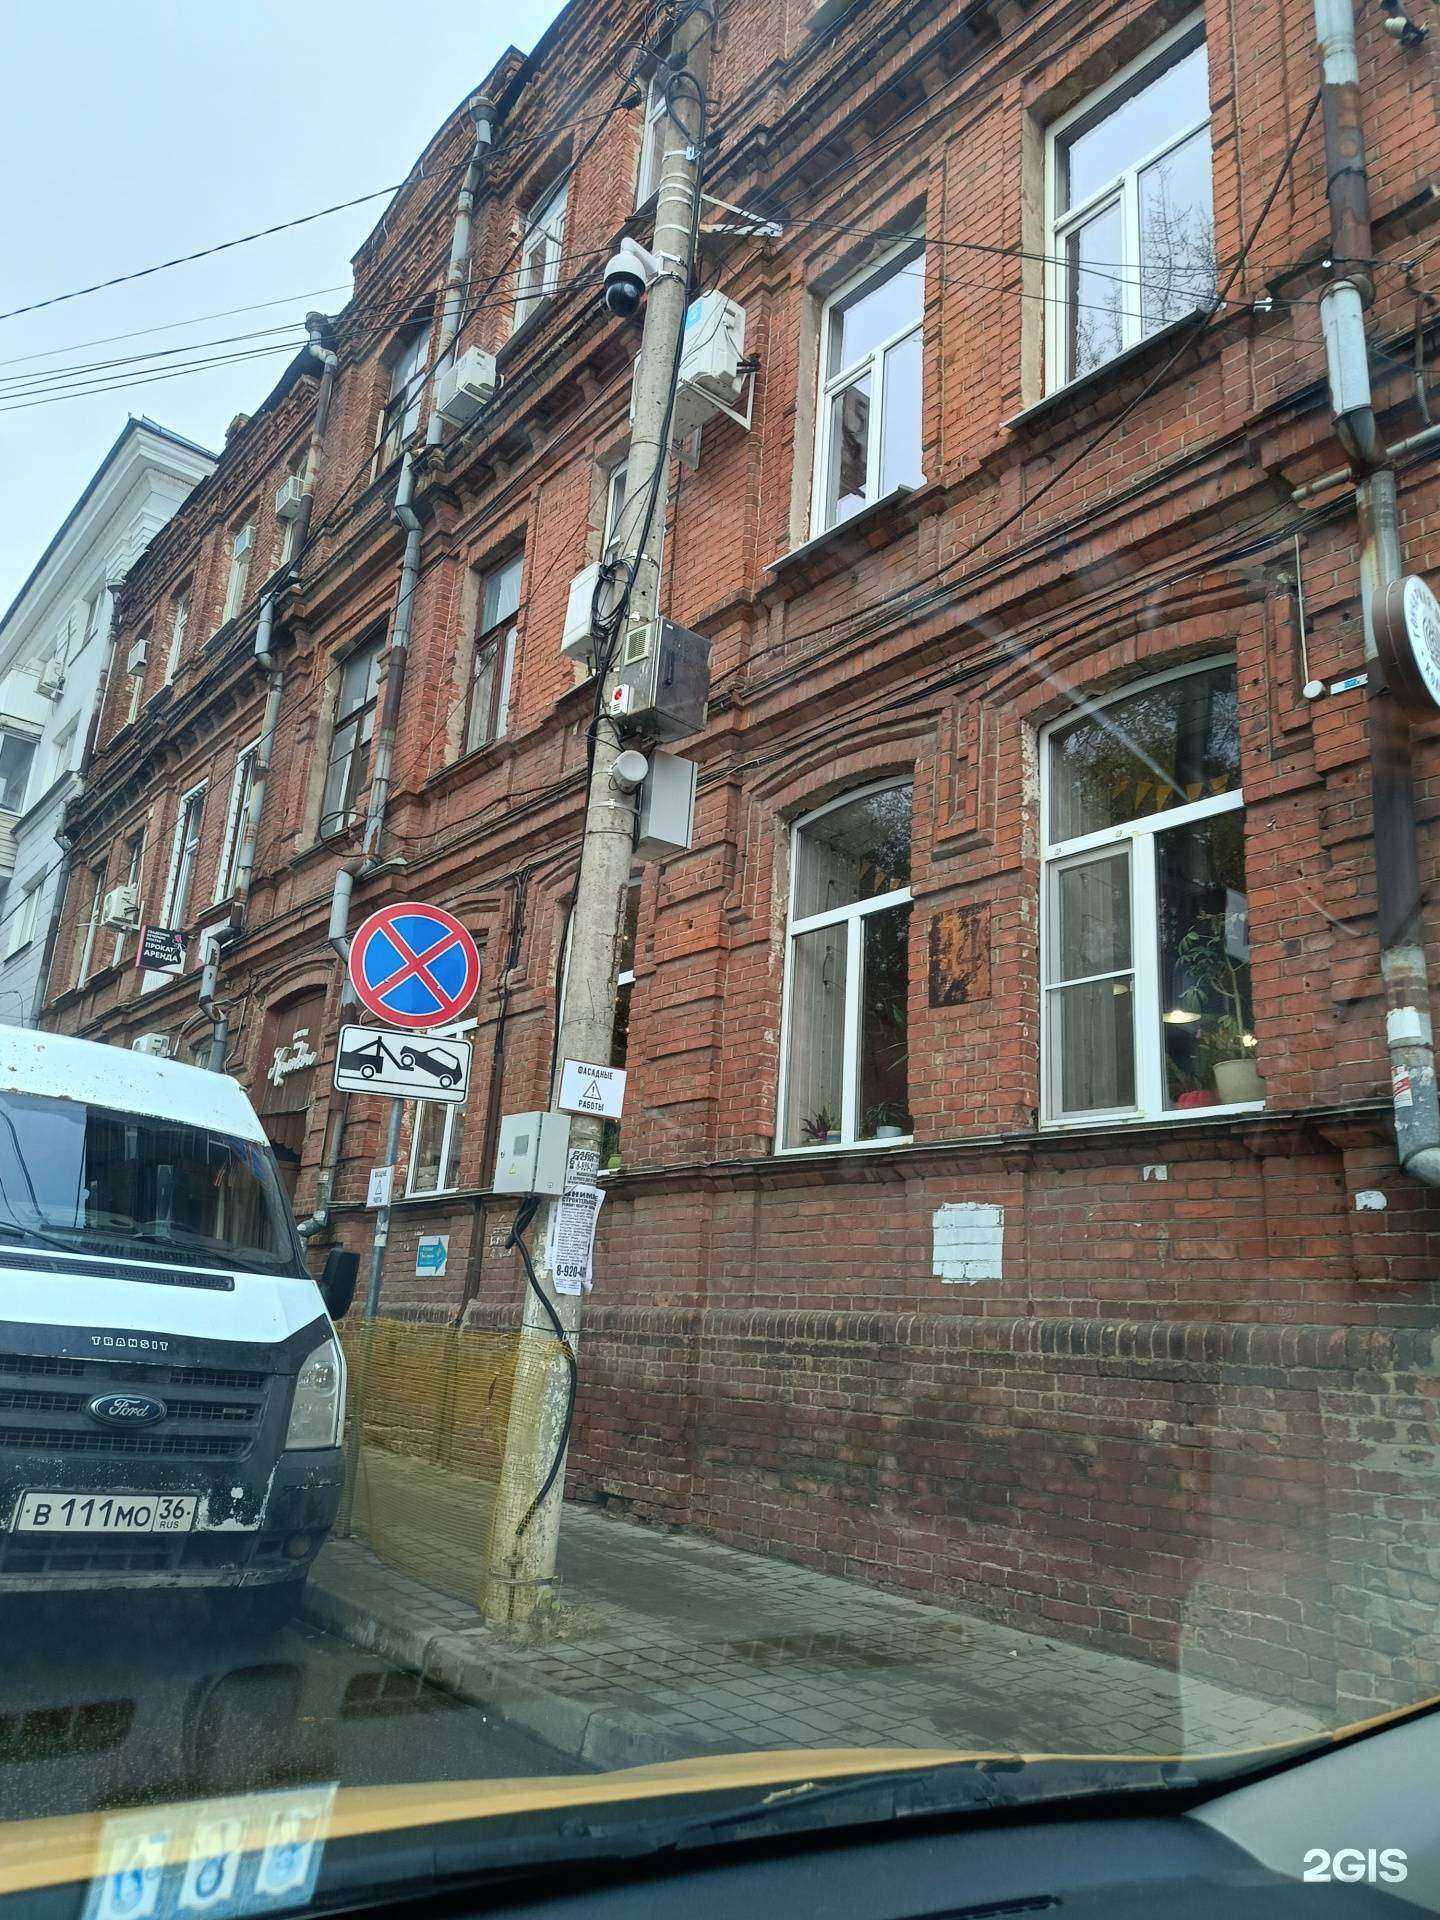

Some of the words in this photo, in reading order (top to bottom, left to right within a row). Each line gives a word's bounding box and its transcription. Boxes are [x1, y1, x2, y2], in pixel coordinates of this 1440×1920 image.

[145, 942, 175, 953] ПРОКАТ
[144, 950, 178, 962] АРЕНДА
[577, 1066, 614, 1081] ФАСАДНЫЕ
[578, 1099, 605, 1112] РАБОТЫ
[91, 1336, 169, 1351] TRANSIT
[108, 1398, 150, 1417] Ford
[159, 1499, 185, 1520] 36
[159, 1521, 180, 1529] RUS
